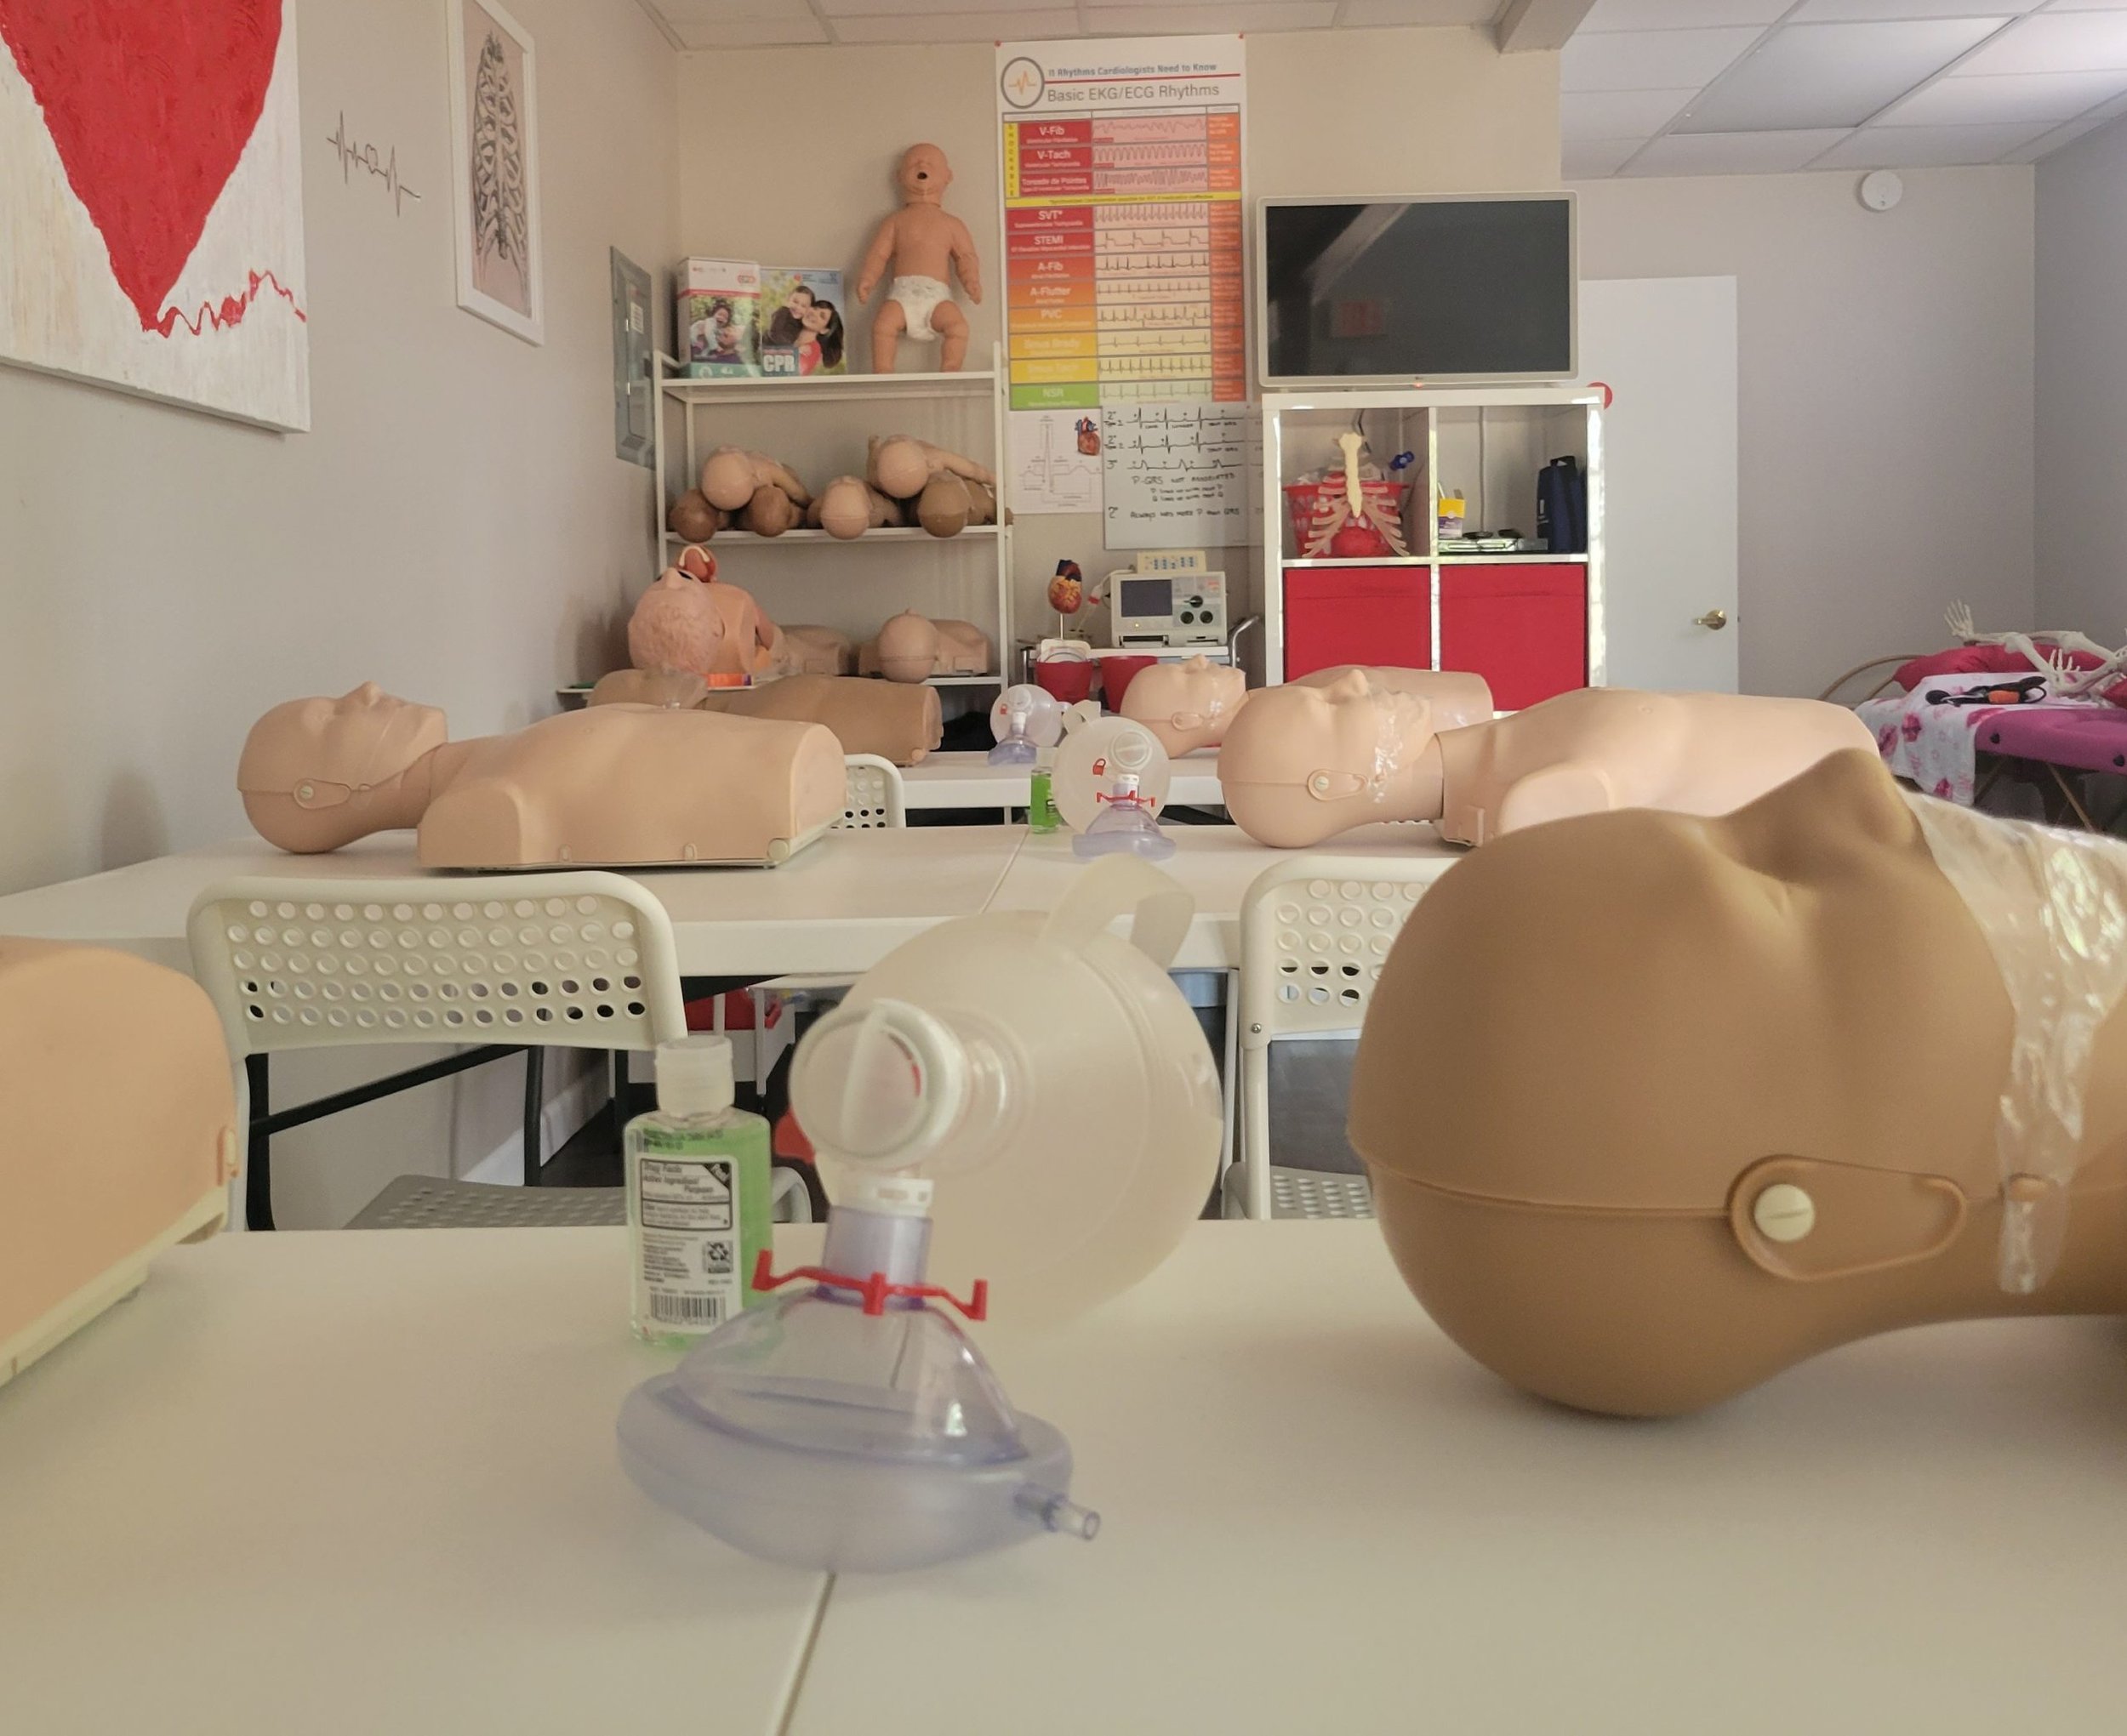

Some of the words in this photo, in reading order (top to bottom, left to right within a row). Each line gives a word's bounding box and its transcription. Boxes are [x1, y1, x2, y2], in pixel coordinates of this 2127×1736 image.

[1058, 68, 1095, 78] Rhythms
[1098, 65, 1155, 76] Cardiologists
[1157, 64, 1179, 73] Need
[1193, 63, 1217, 71] Know
[1047, 88, 1084, 102] Basic
[1089, 86, 1154, 100] EKG/ECG
[1159, 83, 1219, 100] Rhythms
[1039, 126, 1064, 136] V-Fib
[1037, 150, 1071, 160] V-Tach
[1034, 235, 1064, 245] STEMI
[763, 355, 795, 373] CPR
